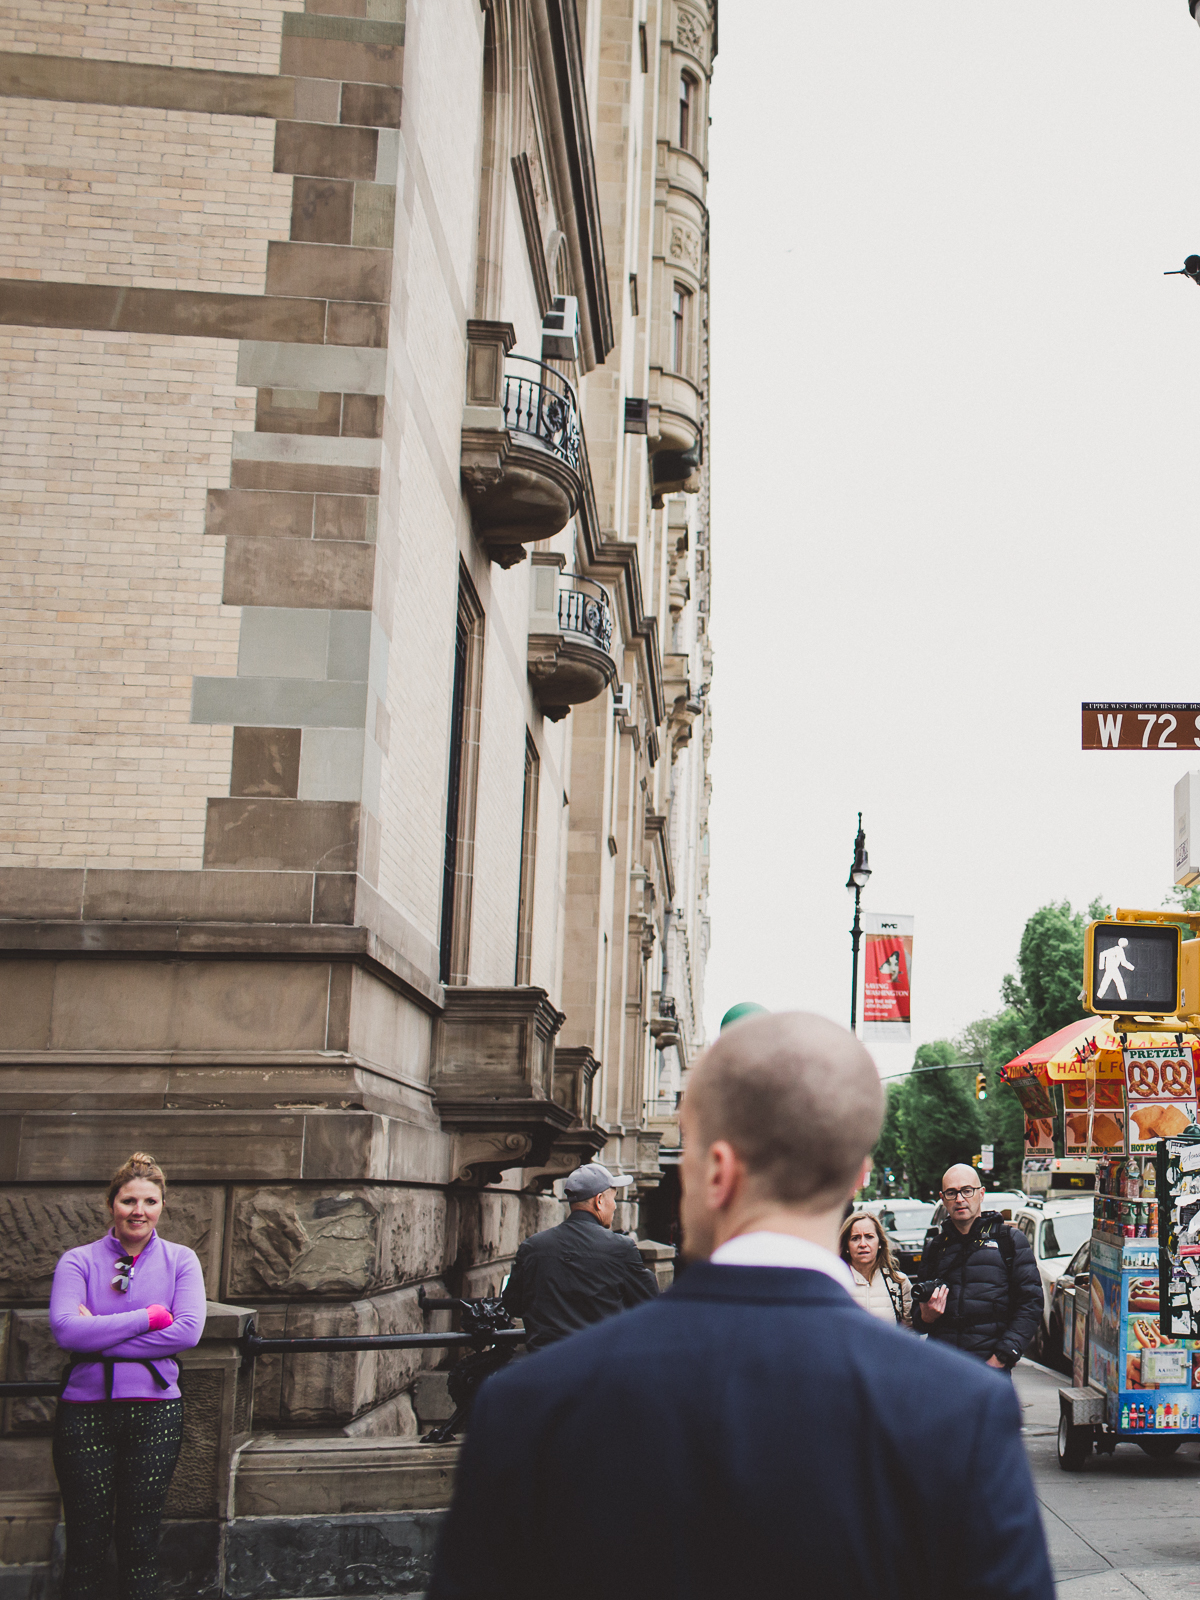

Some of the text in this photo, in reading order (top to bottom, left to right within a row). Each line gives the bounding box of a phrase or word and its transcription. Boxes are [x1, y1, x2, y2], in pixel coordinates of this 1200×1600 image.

[1097, 713, 1123, 748] W
[1137, 713, 1177, 748] 72
[1129, 1049, 1187, 1059] PRETZEL
[1131, 1143, 1144, 1152] HOT
